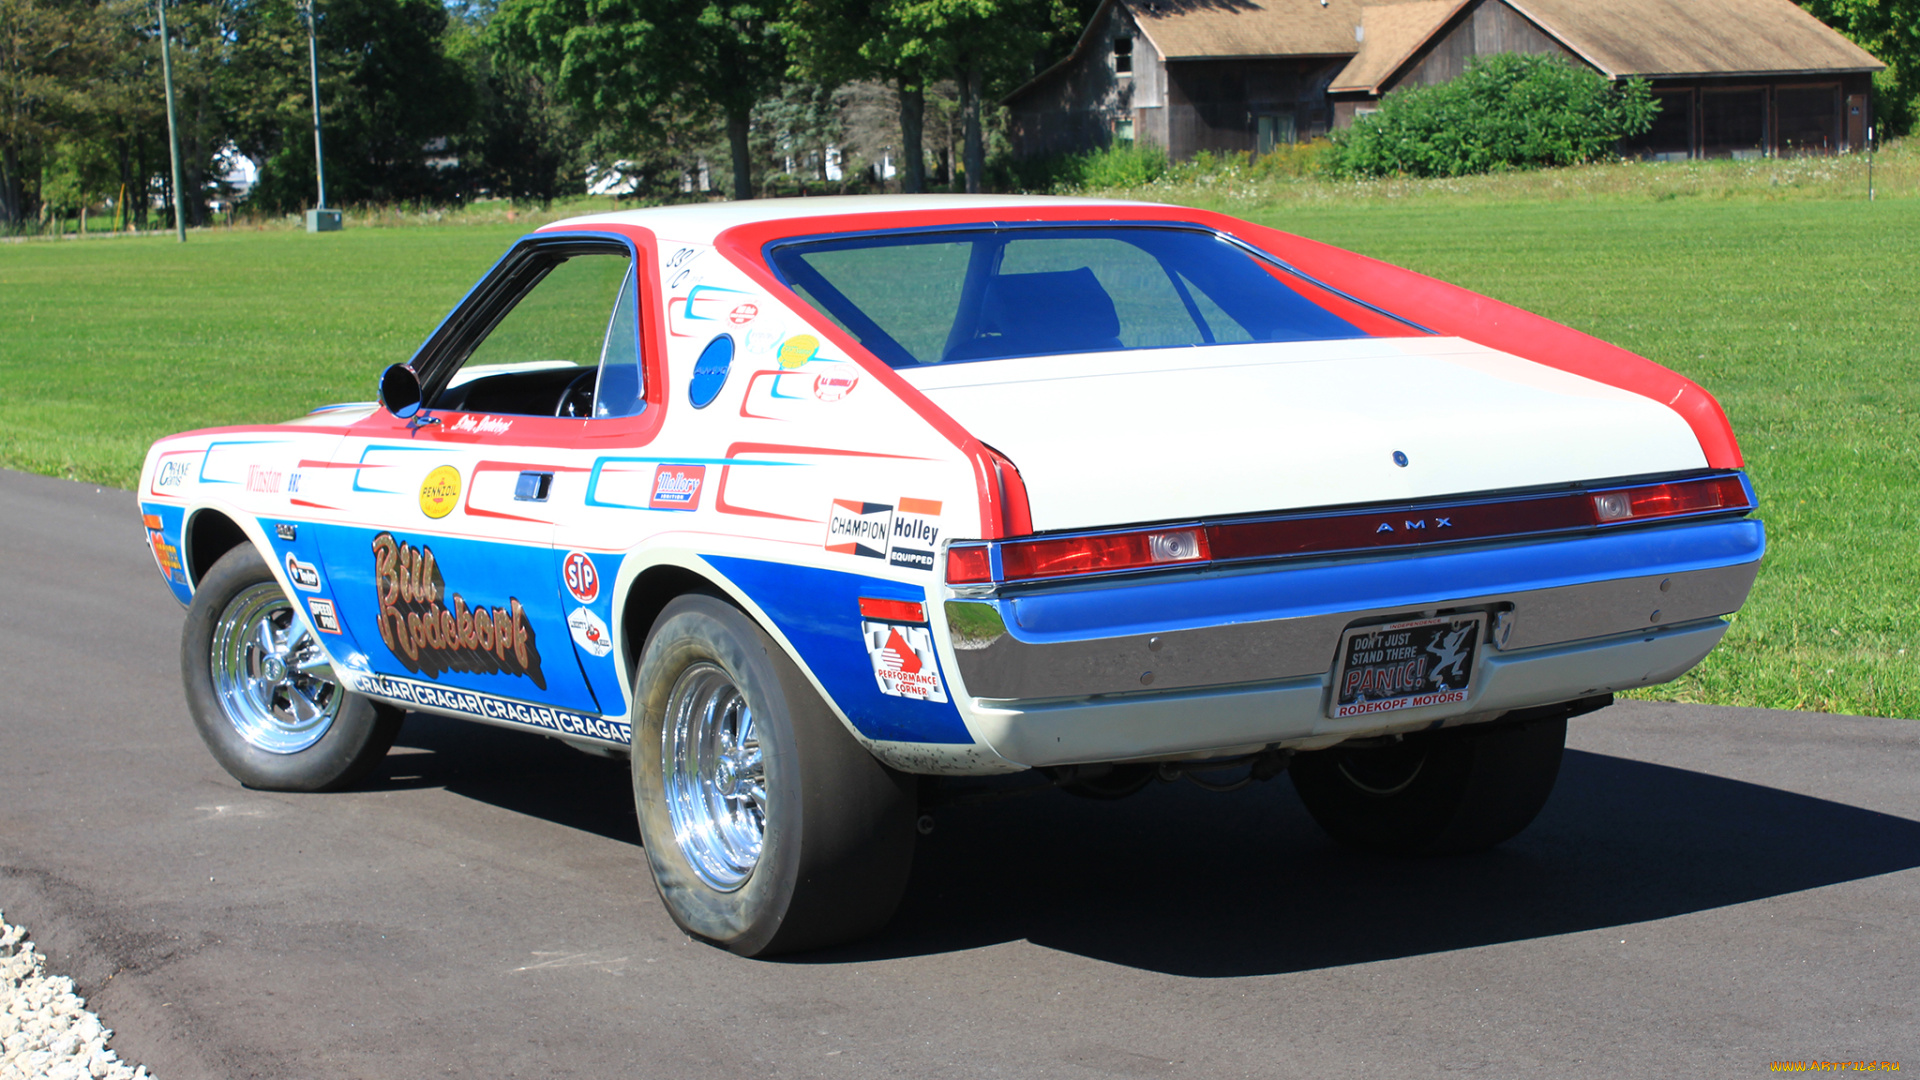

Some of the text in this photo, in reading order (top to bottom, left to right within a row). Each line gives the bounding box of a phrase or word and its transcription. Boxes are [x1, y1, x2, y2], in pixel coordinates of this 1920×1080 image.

[246, 464, 282, 493] Winston
[658, 471, 700, 494] Mallory
[423, 485, 456, 498] PENNZOIL
[831, 516, 887, 540] CHAMPION
[893, 516, 939, 546] Holley
[1376, 517, 1452, 533] AMX
[372, 532, 440, 605] Bill
[891, 551, 933, 565] EQUIPPED
[568, 555, 594, 594] STP
[376, 595, 530, 671] Rodekopf
[1389, 618, 1441, 629] INDEPENDENCE
[1385, 633, 1411, 647] JUST
[1351, 645, 1418, 665] STAND THERE
[878, 668, 937, 686] PERFORMANCE
[1345, 657, 1426, 696] PANIC!
[895, 683, 928, 696] CORNER
[354, 677, 413, 701] CRAGAR
[415, 686, 482, 713] CRAGAR
[484, 699, 556, 728] CRAGAR
[1339, 692, 1464, 716] RODEKOPF MOTORS
